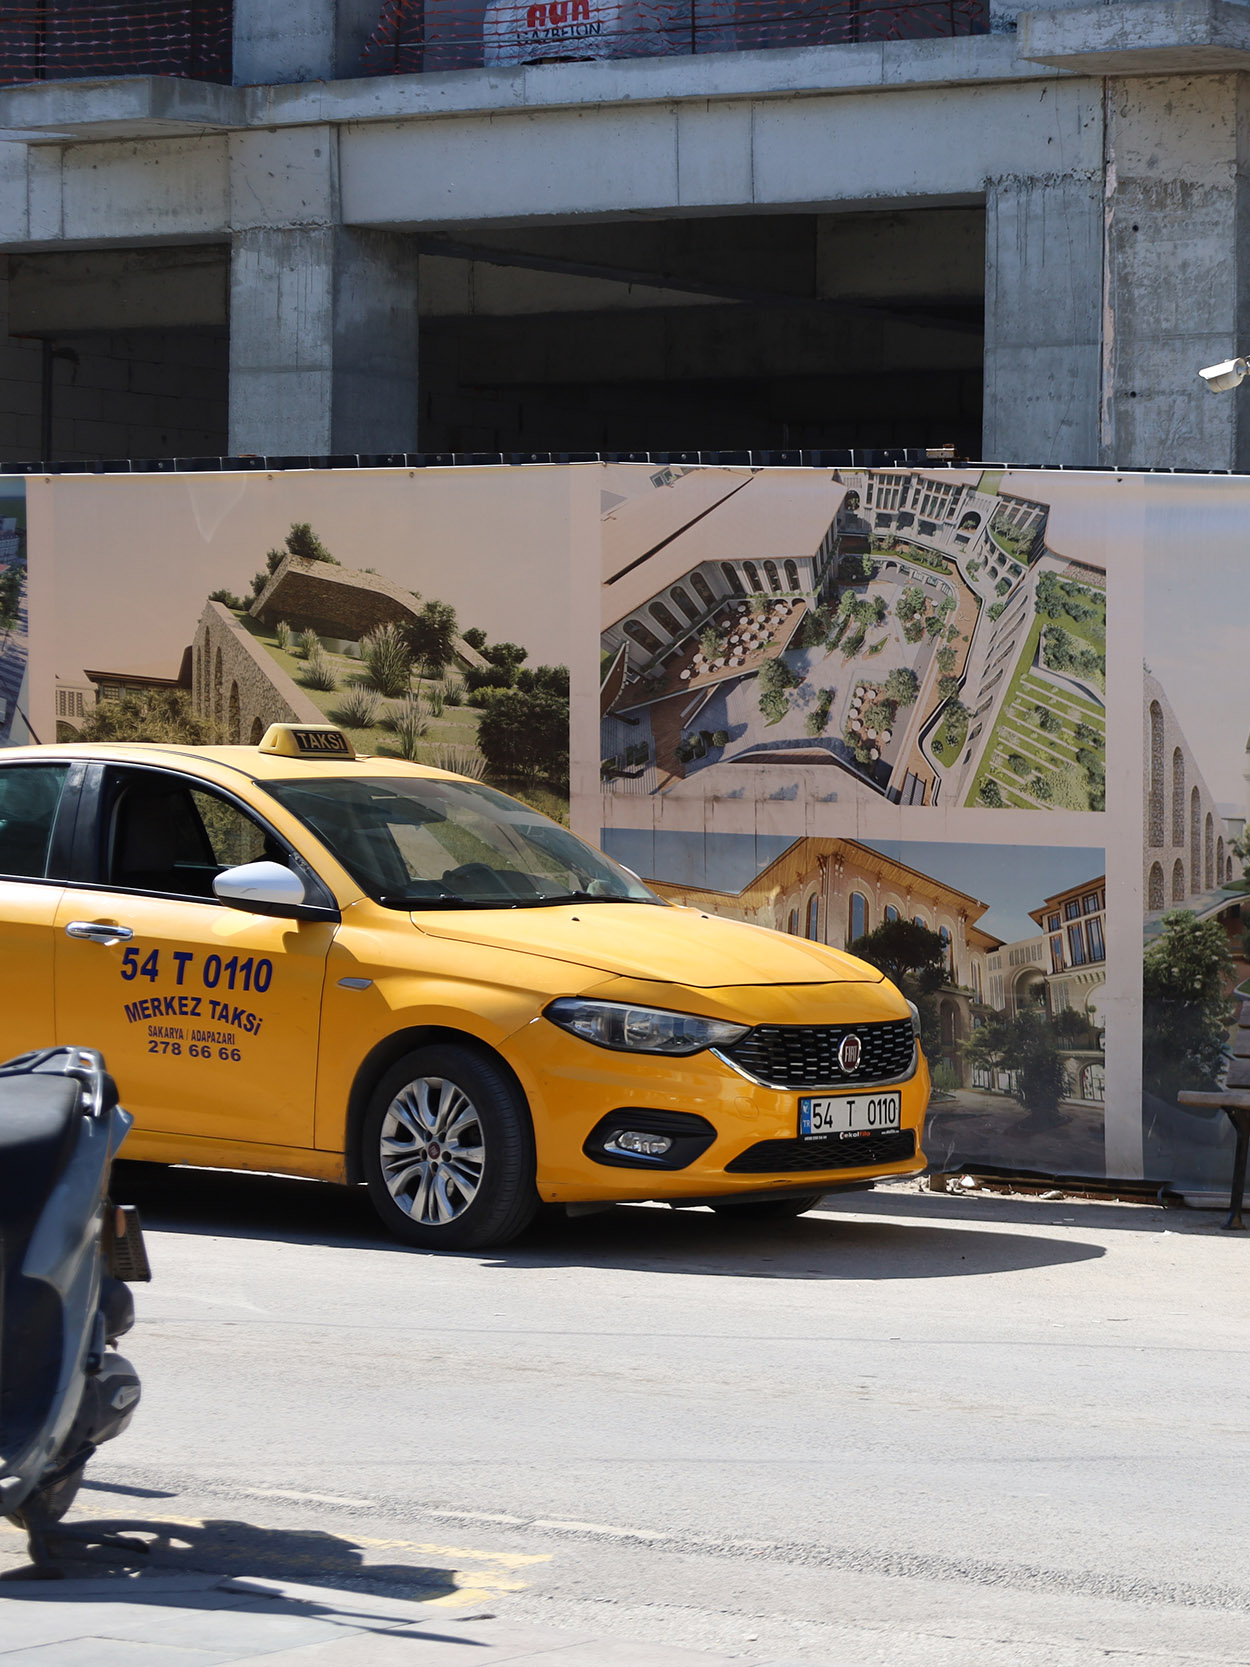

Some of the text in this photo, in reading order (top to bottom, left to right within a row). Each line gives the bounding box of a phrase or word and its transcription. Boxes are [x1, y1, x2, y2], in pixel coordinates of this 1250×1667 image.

[120, 947, 273, 993] 54 T 0110
[124, 996, 202, 1024] MERKEZ
[148, 1025, 184, 1040] SAKARYA
[191, 1029, 236, 1045] ADAPAZARI
[148, 1040, 242, 1062] 278 66 66
[844, 1045, 857, 1063] FIAT
[803, 1119, 811, 1128] TR
[812, 1098, 896, 1129] 54 T 0110
